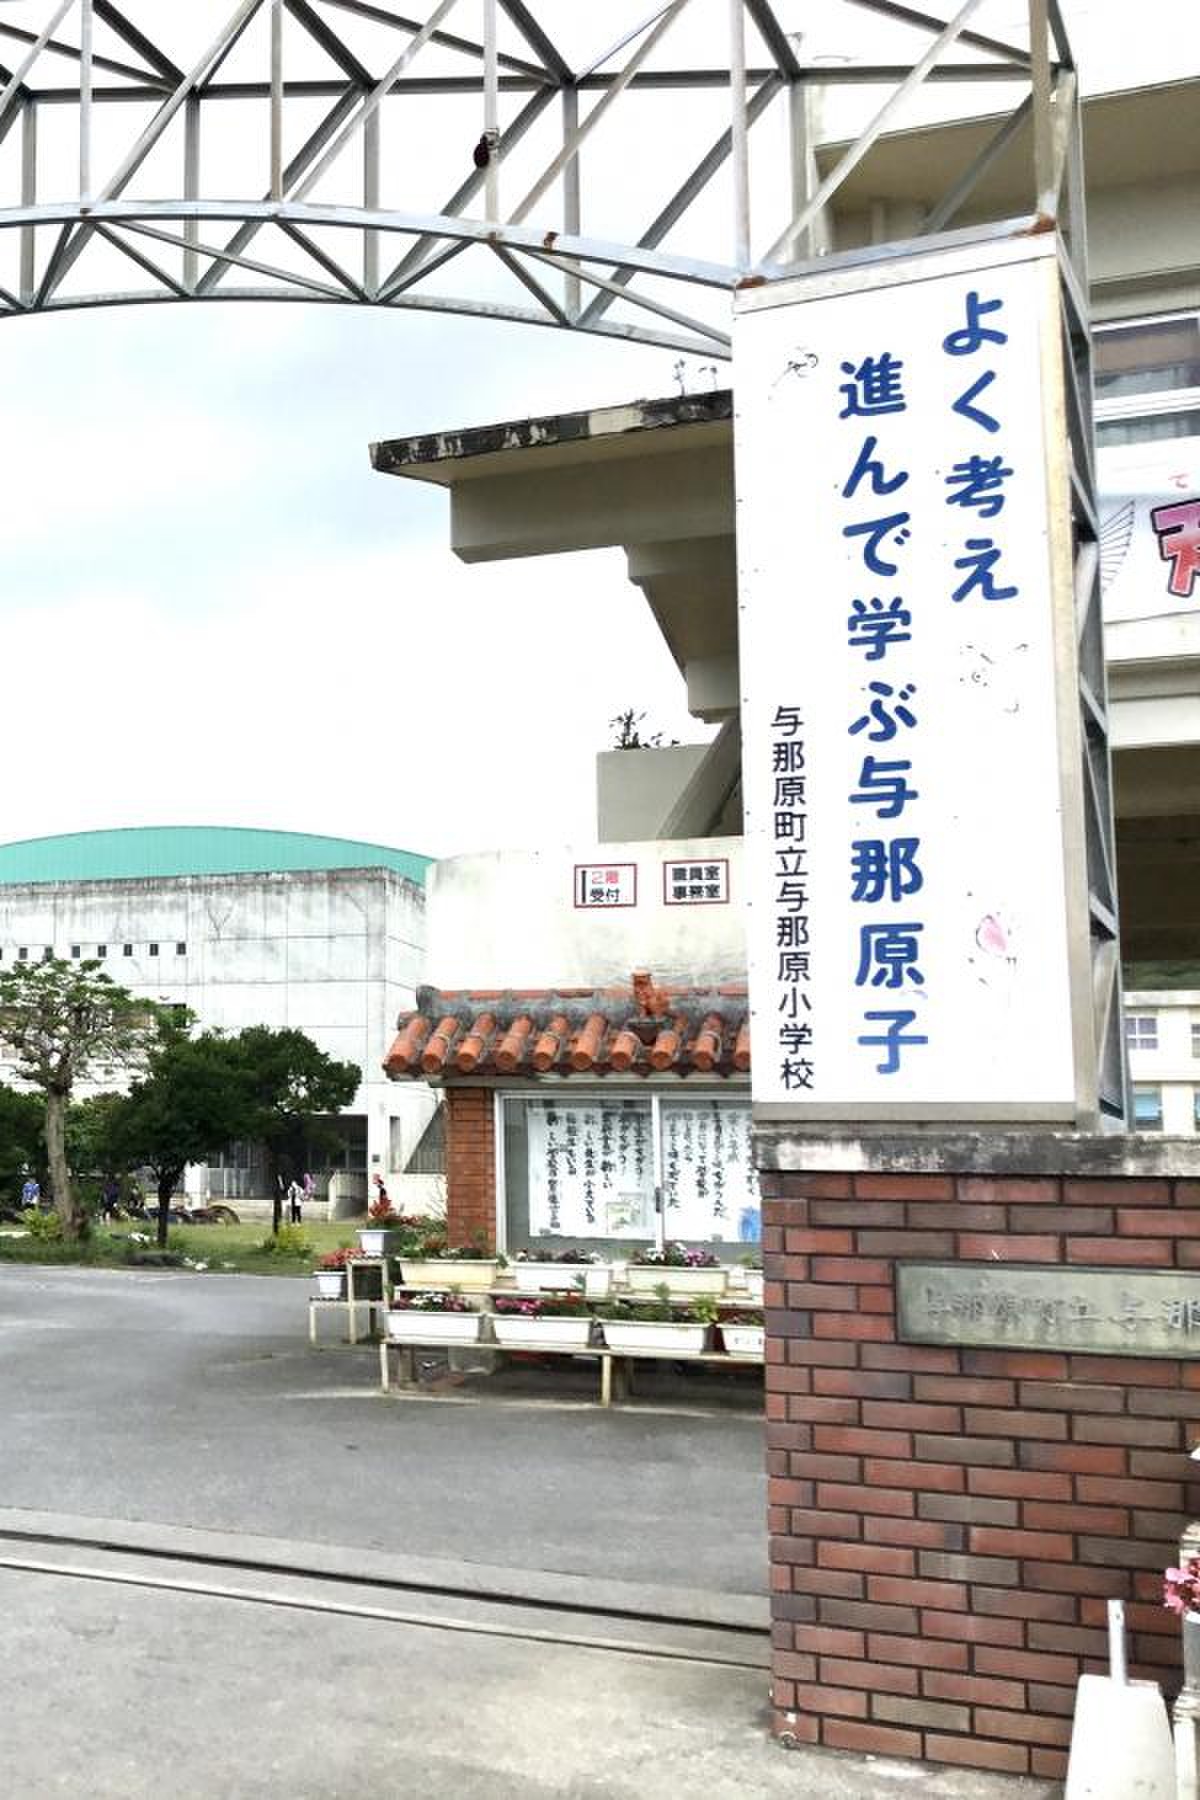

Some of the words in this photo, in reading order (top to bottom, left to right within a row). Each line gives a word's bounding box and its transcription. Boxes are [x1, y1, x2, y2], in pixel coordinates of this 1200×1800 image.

[942, 291, 1019, 602] よく考え
[770, 704, 814, 1090] 与那原町立与那原小学校
[838, 351, 929, 1075] 進んで学ぶ与那原子
